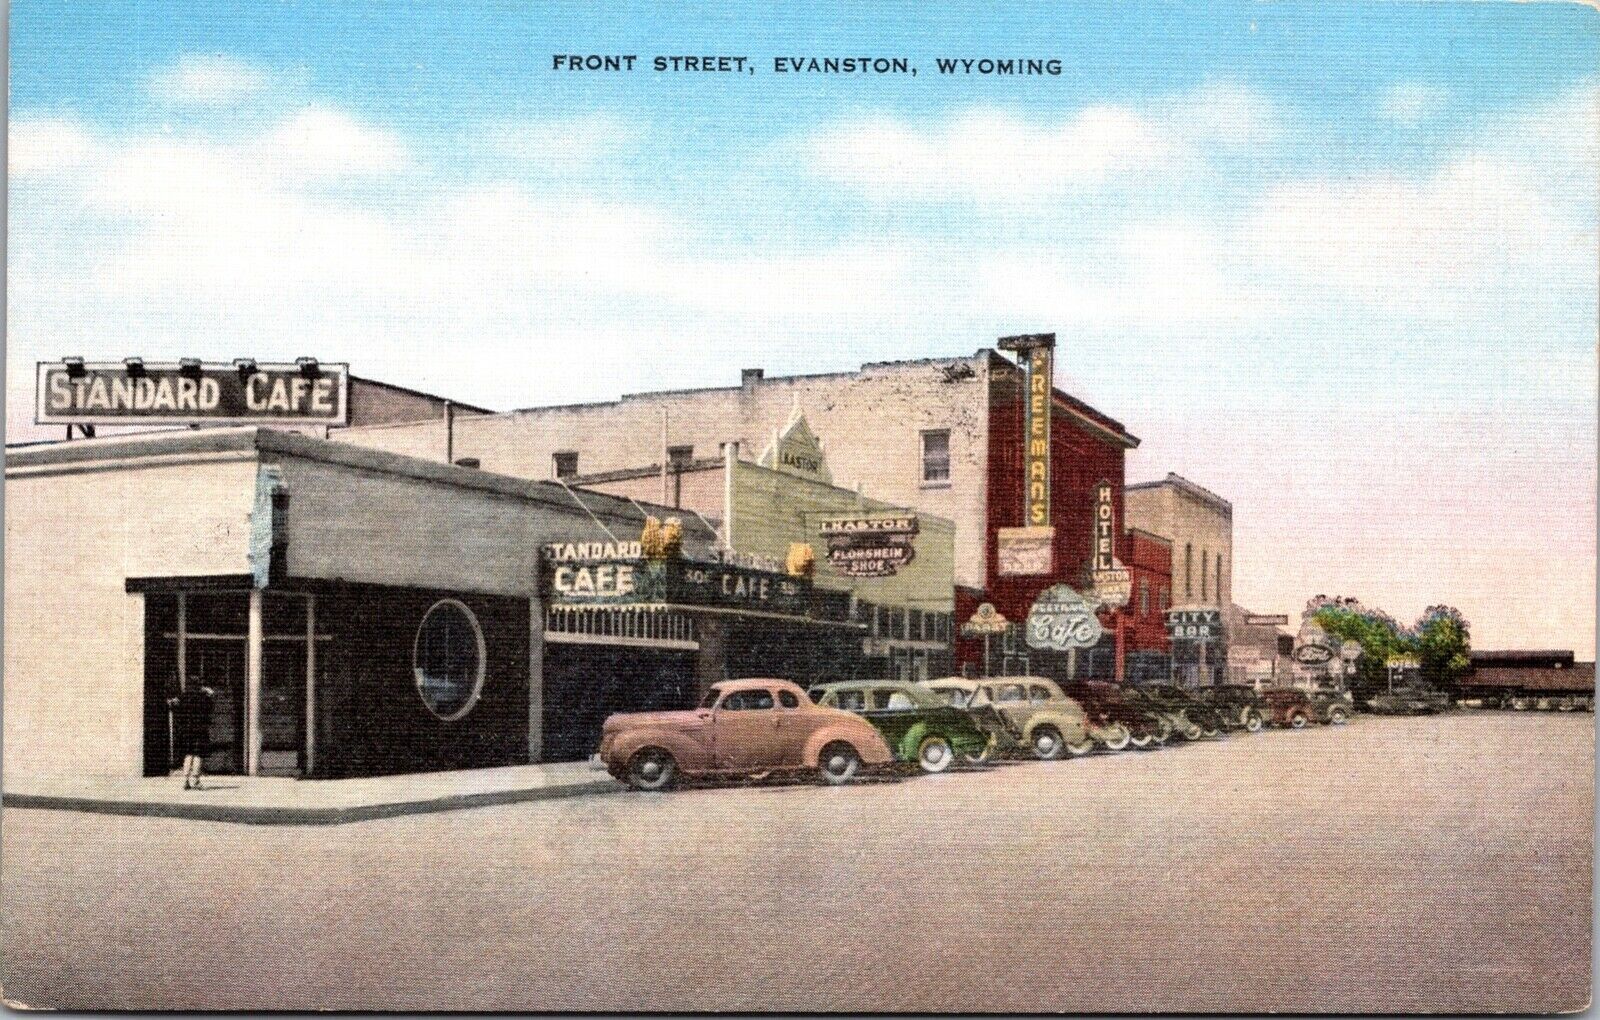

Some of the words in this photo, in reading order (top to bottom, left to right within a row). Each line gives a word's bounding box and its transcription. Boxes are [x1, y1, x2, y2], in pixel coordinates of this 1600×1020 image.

[49, 372, 220, 411] STANDARD
[245, 371, 334, 412] CAFE
[1100, 485, 1112, 569] HOTEL
[554, 564, 634, 592] CAFE
[851, 559, 885, 572] SHOE
[722, 573, 770, 600] CAFE
[1169, 611, 1214, 623] CITY
[1174, 624, 1210, 638] BAR
